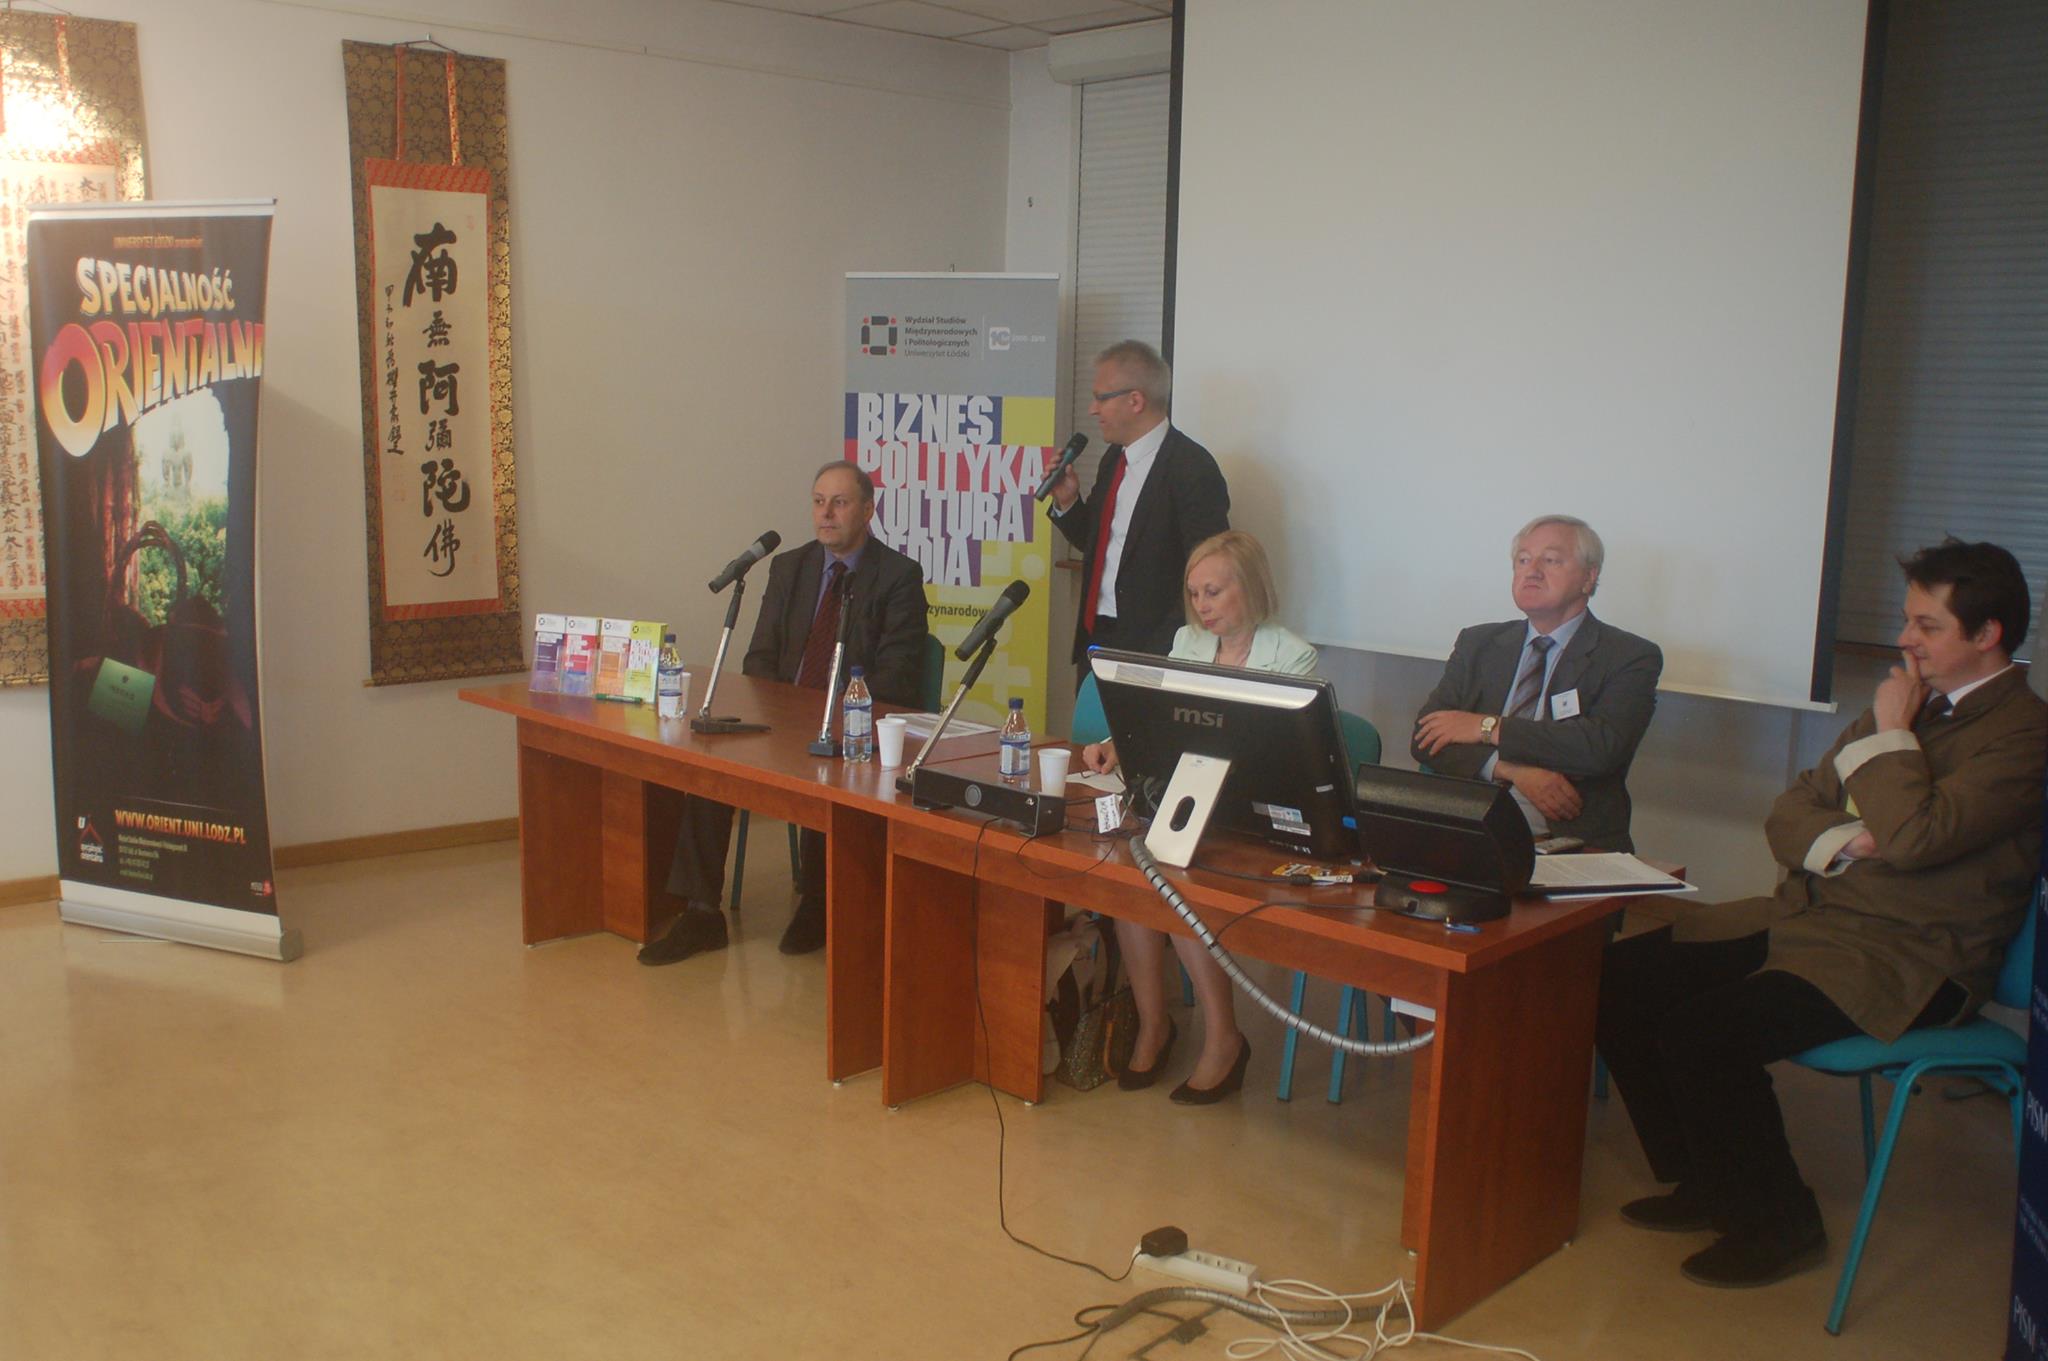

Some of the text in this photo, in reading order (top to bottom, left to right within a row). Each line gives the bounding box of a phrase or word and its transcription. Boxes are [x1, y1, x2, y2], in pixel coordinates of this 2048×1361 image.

[77, 257, 235, 318] SPECJALNOŚĆ
[904, 316, 966, 325] Wydział Studiów
[858, 393, 994, 445] BIZNES
[857, 438, 1042, 495] POLITYKA
[1174, 706, 1225, 729] msi
